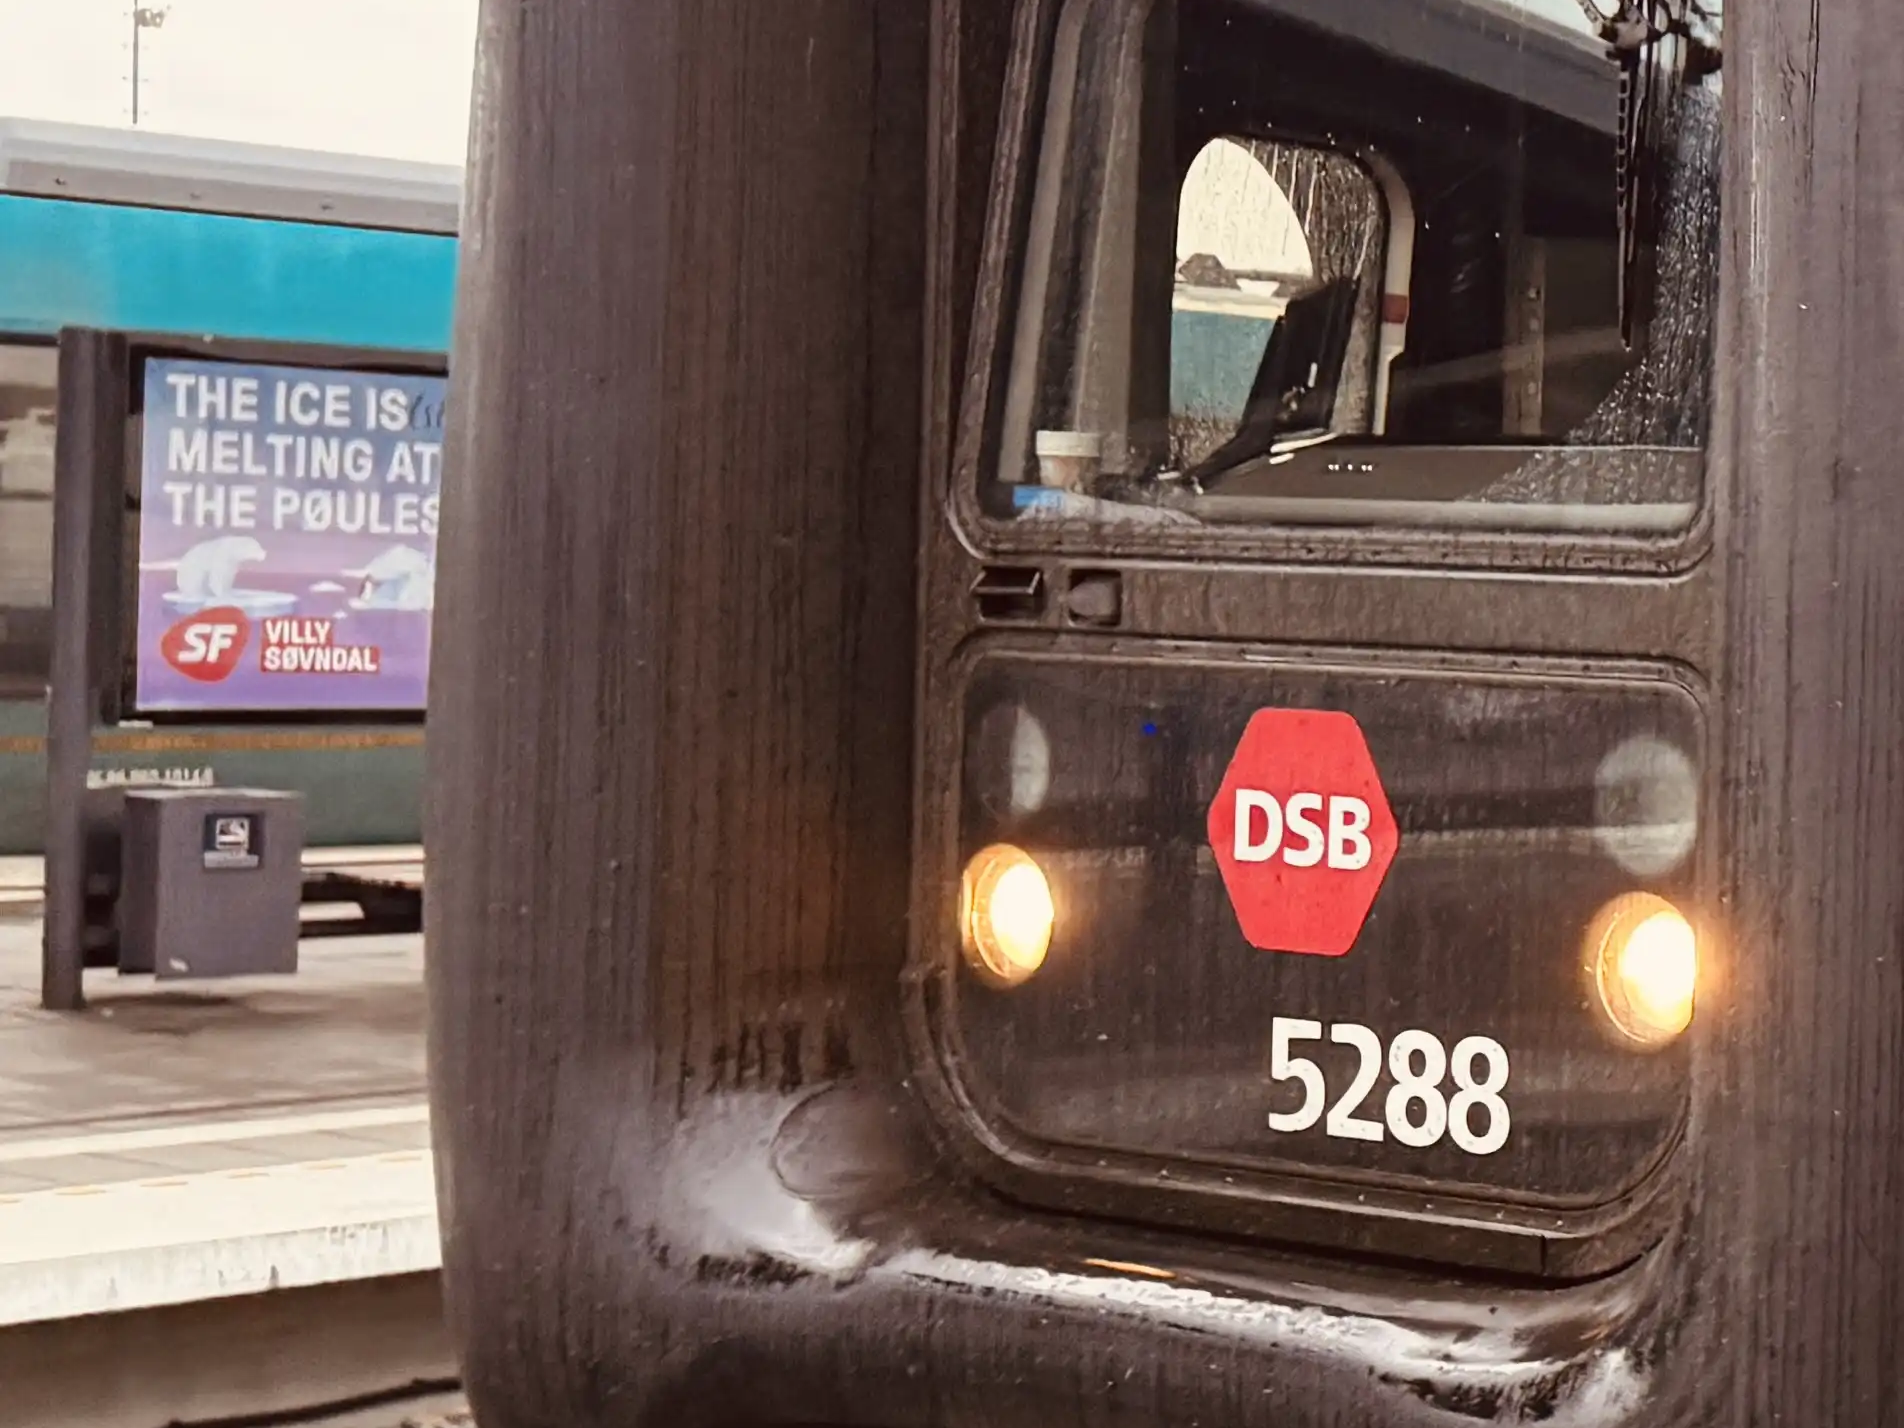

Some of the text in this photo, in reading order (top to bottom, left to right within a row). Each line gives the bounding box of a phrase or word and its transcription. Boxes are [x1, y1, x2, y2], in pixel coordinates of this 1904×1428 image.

[166, 373, 259, 422] THE
[275, 380, 351, 427] ICE
[366, 387, 409, 431] IS
[167, 427, 440, 484] MELTING AT
[163, 481, 257, 529] THE
[178, 623, 238, 663] SF
[265, 619, 330, 644] VILLY
[263, 645, 378, 671] SØVNDAL
[1233, 788, 1372, 871] DSB
[1268, 1016, 1510, 1155] 5288
